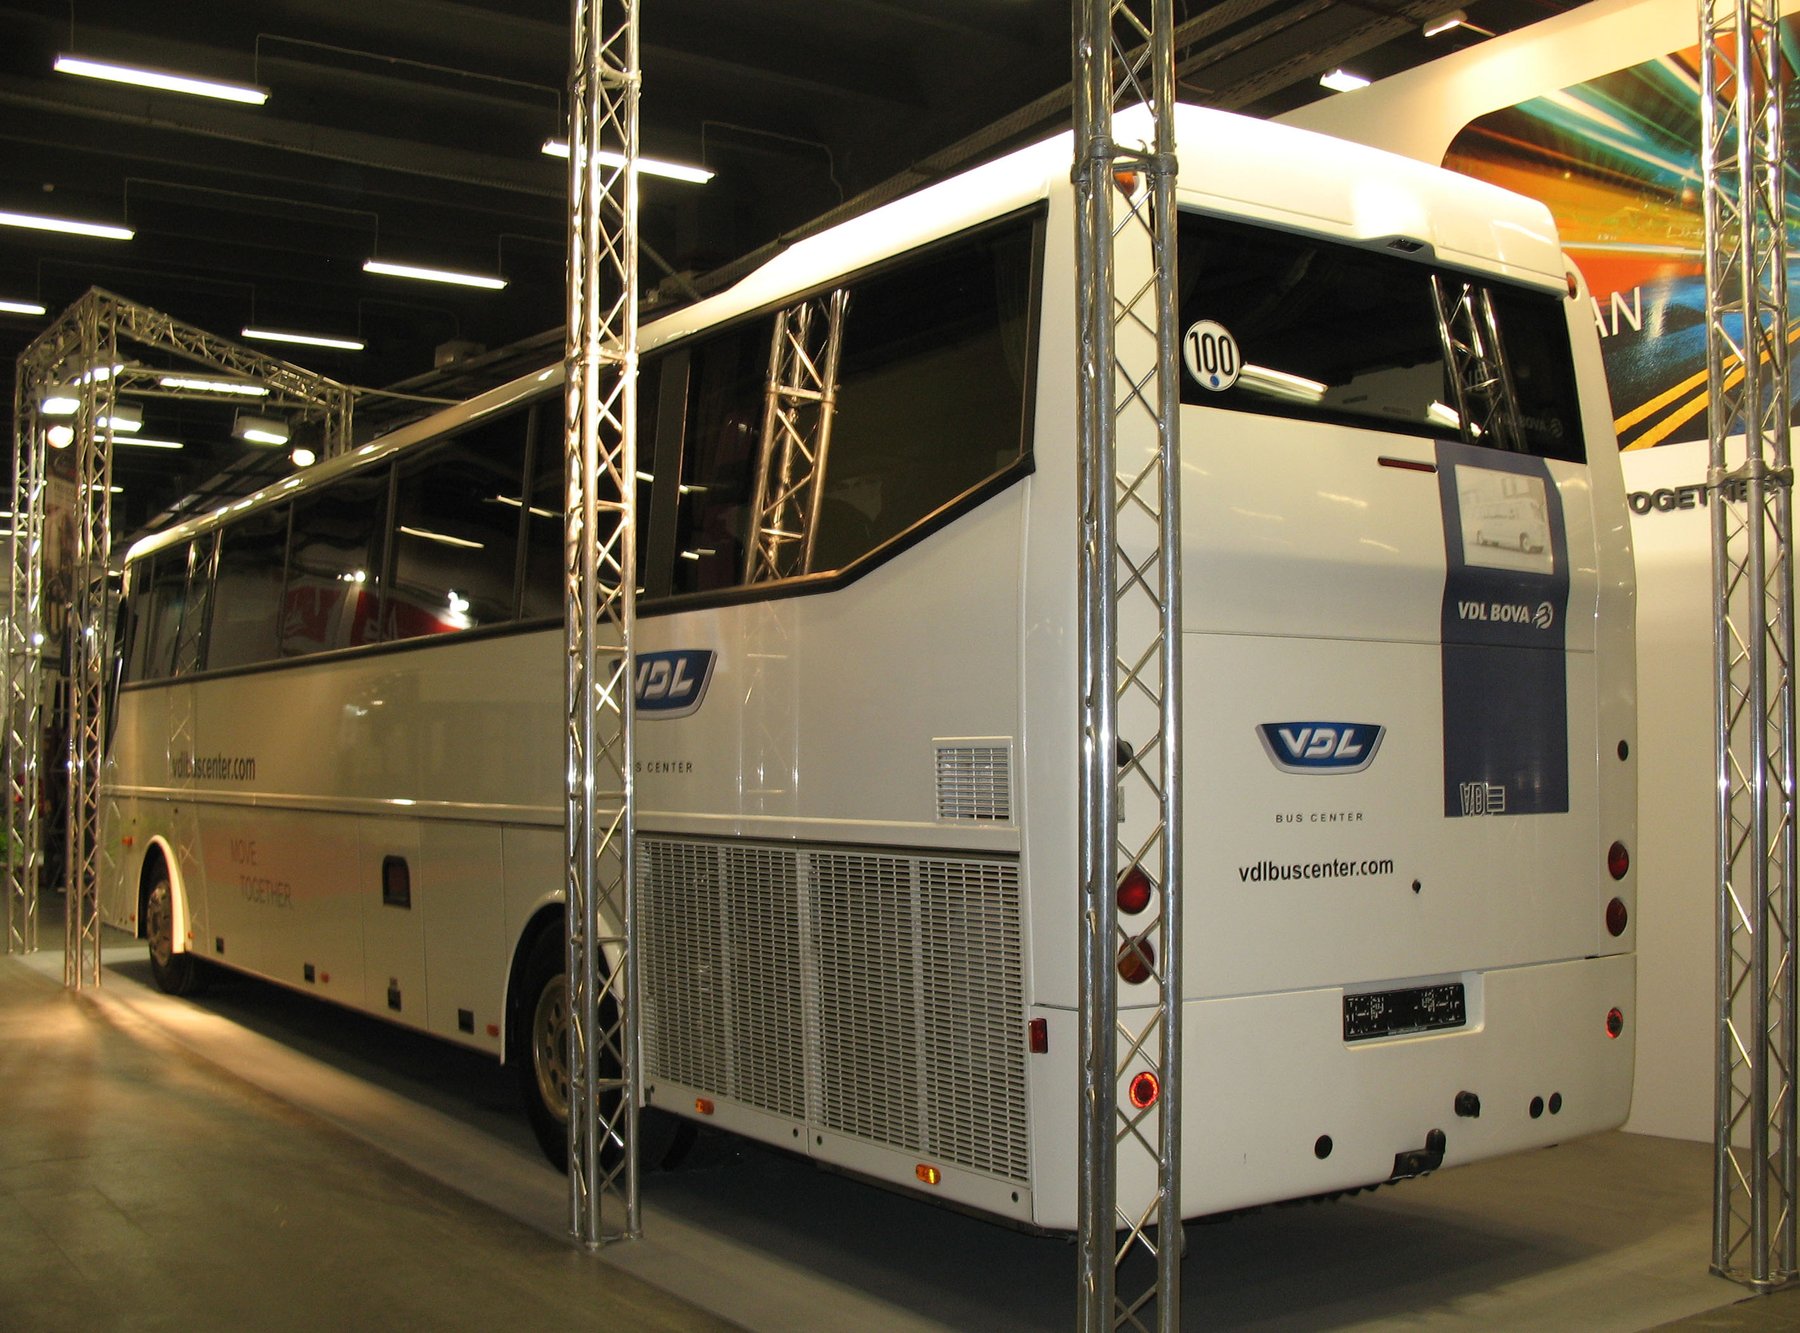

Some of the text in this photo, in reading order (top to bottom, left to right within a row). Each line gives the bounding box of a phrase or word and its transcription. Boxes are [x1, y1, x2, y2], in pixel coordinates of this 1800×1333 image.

[1189, 331, 1234, 377] 100
[1458, 601, 1531, 623] VDL BOVA
[1278, 727, 1364, 759] VDL
[647, 762, 693, 773] CENTER
[1275, 812, 1364, 823] BUS CENTER
[1238, 858, 1394, 882] vdlbuscenter.com
